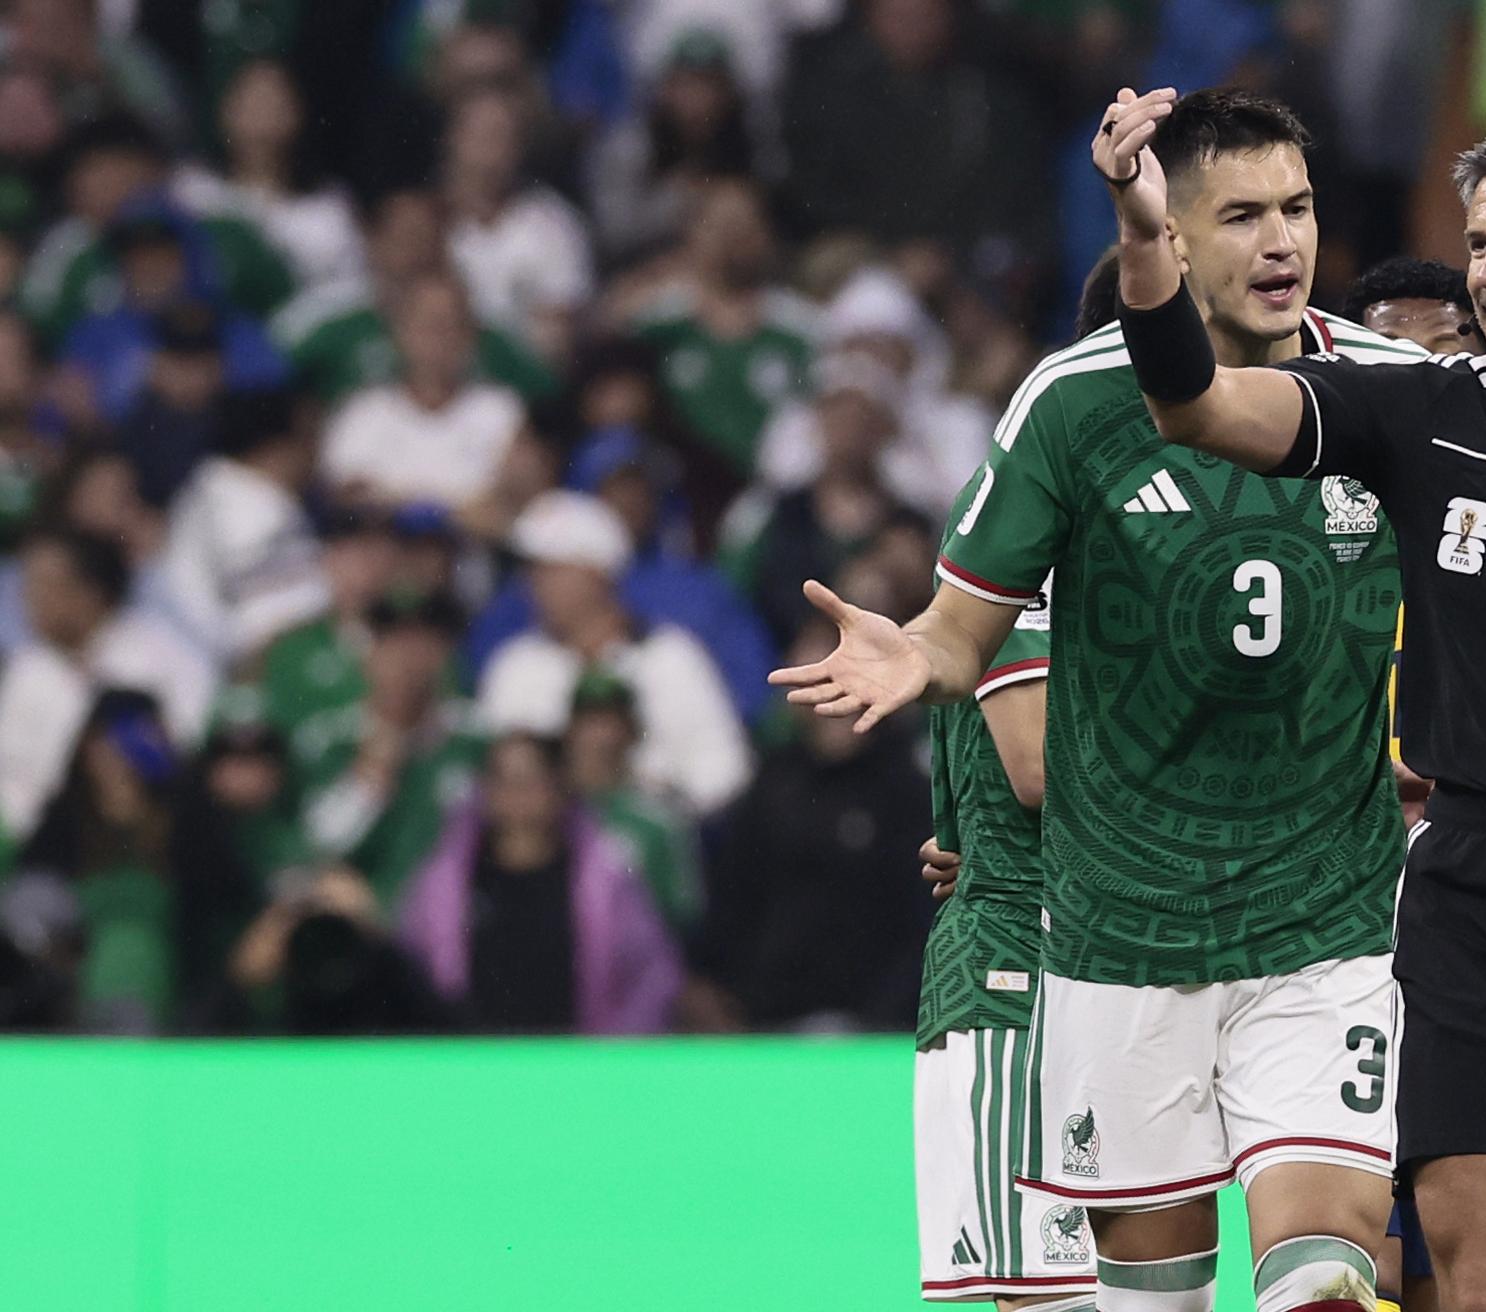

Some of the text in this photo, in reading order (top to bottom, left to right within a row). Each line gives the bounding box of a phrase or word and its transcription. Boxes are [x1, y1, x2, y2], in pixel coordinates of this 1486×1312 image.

[1449, 555, 1470, 567] FIFA
[1233, 559, 1282, 657] 3
[1340, 1025, 1387, 1114] 3
